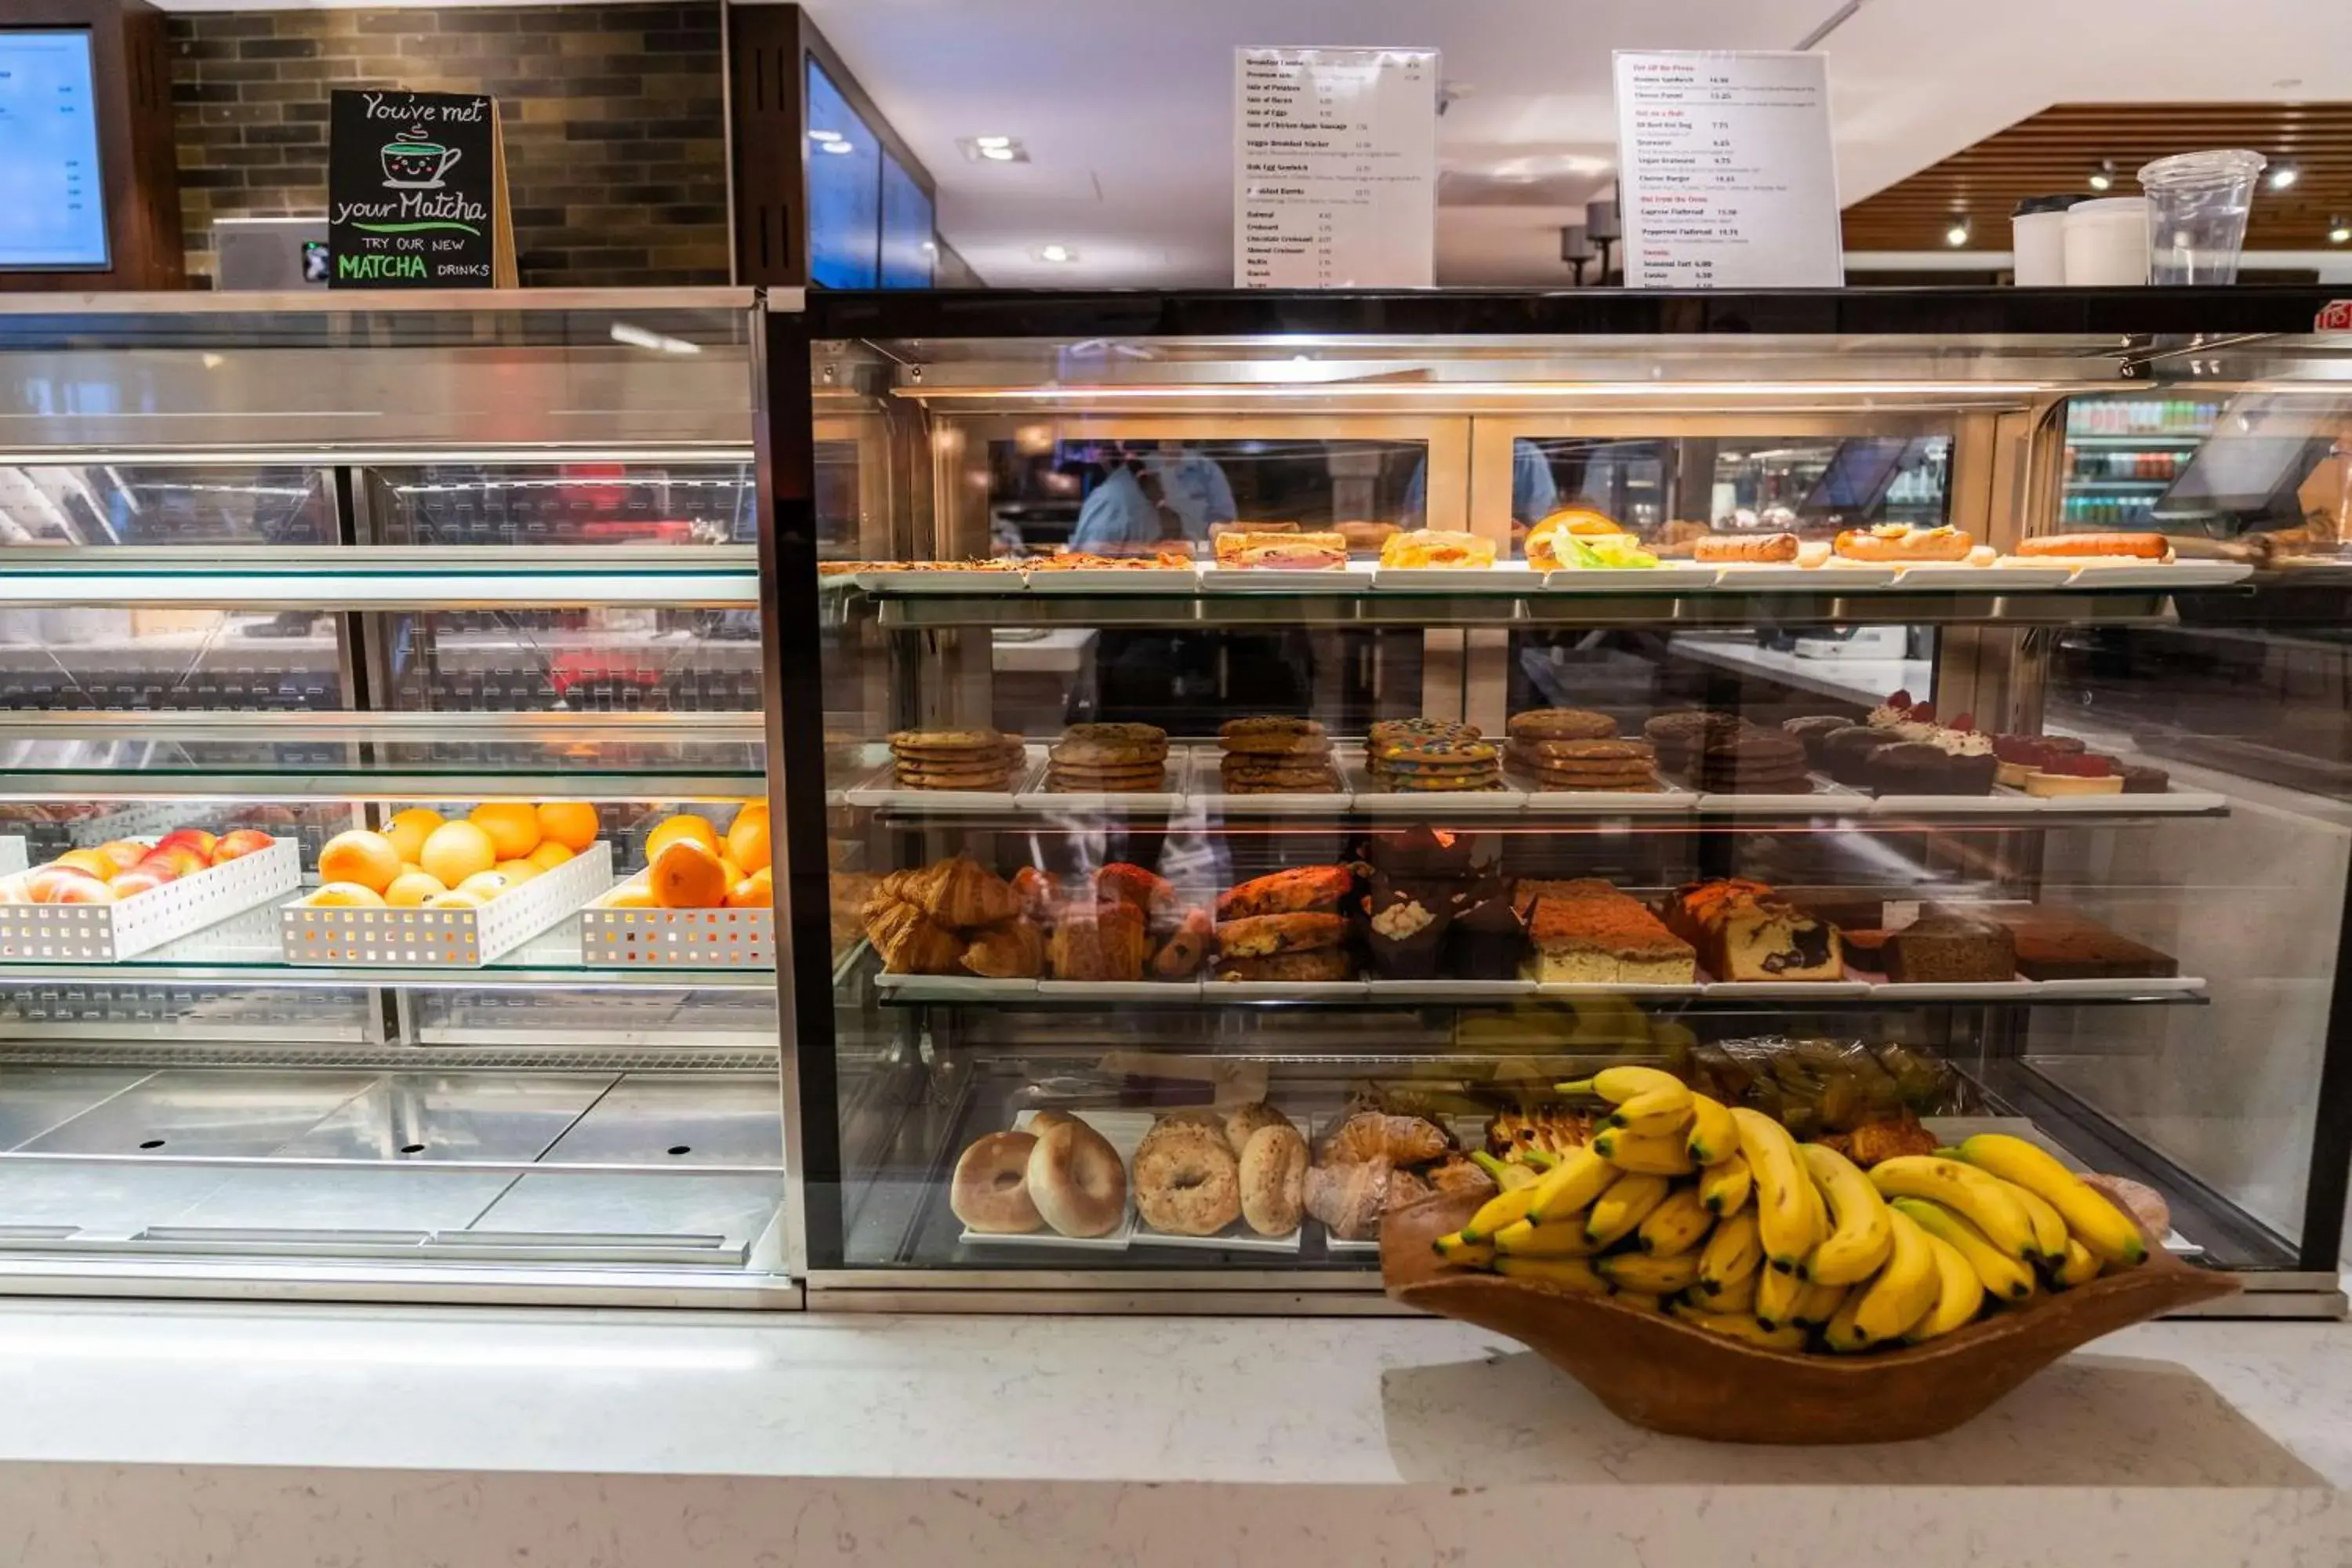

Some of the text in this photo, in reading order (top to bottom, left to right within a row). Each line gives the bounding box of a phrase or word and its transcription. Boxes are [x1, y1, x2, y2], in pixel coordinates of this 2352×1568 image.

[363, 93, 487, 122] You've met
[331, 191, 487, 224] your Matcha
[361, 238, 465, 251] TRY OUR NEW
[338, 253, 489, 279] MATCHA DRINKS
